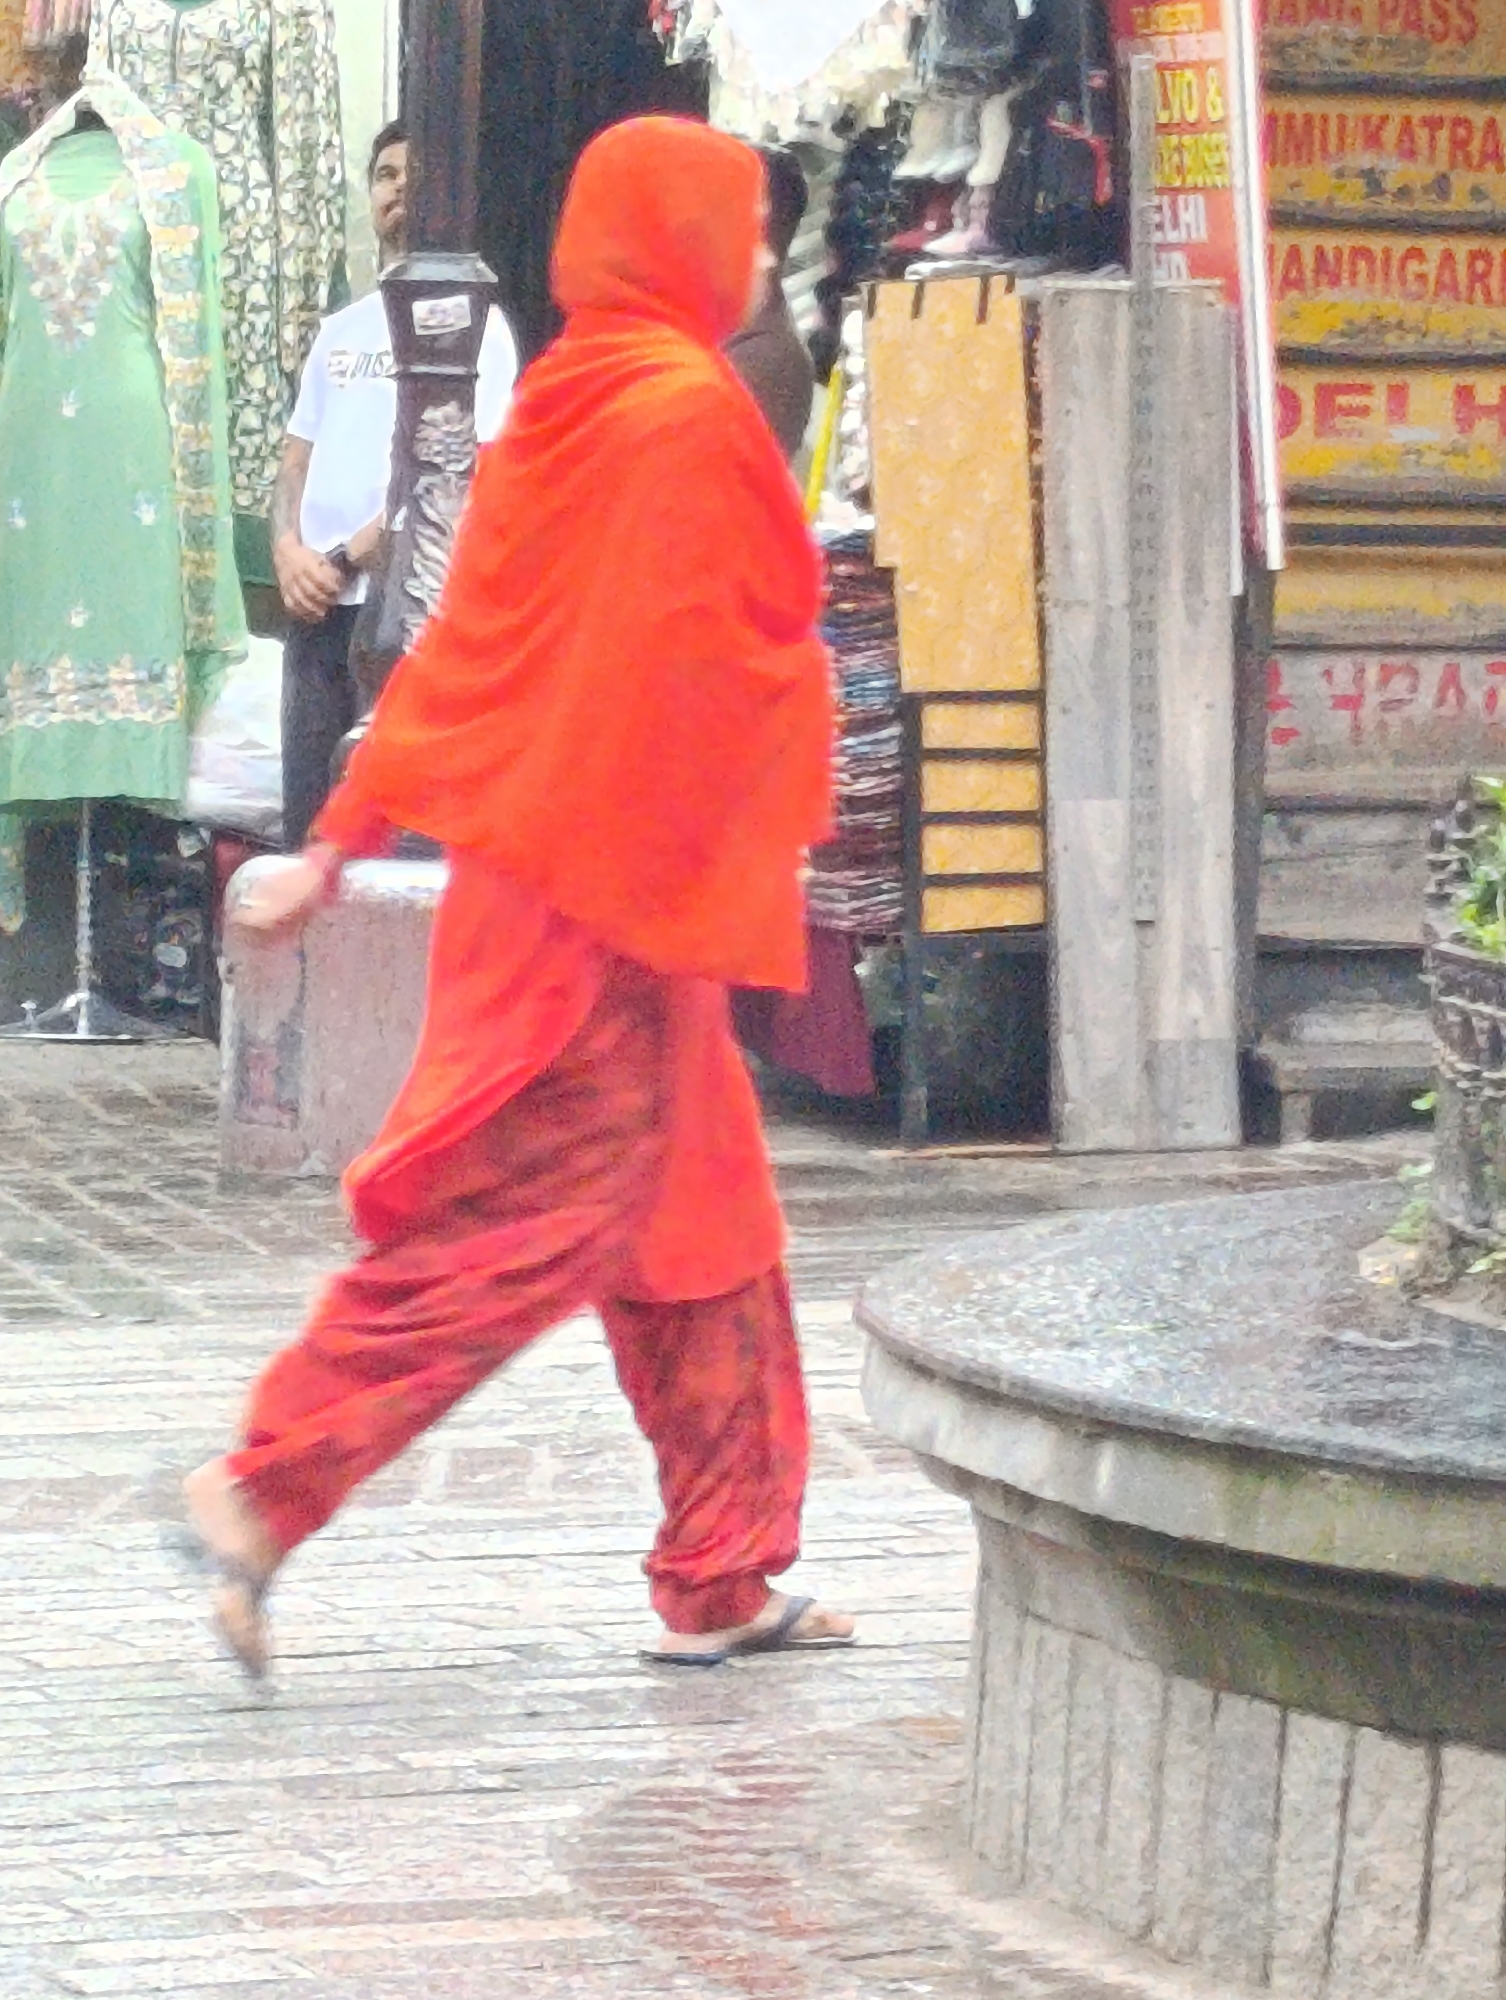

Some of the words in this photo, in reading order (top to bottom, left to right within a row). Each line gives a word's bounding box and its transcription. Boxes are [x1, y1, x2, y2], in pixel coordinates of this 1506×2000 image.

[1205, 66, 1225, 123] &
[1358, 113, 1506, 175] KATRA
[1268, 243, 1506, 308] ANDIGAR
